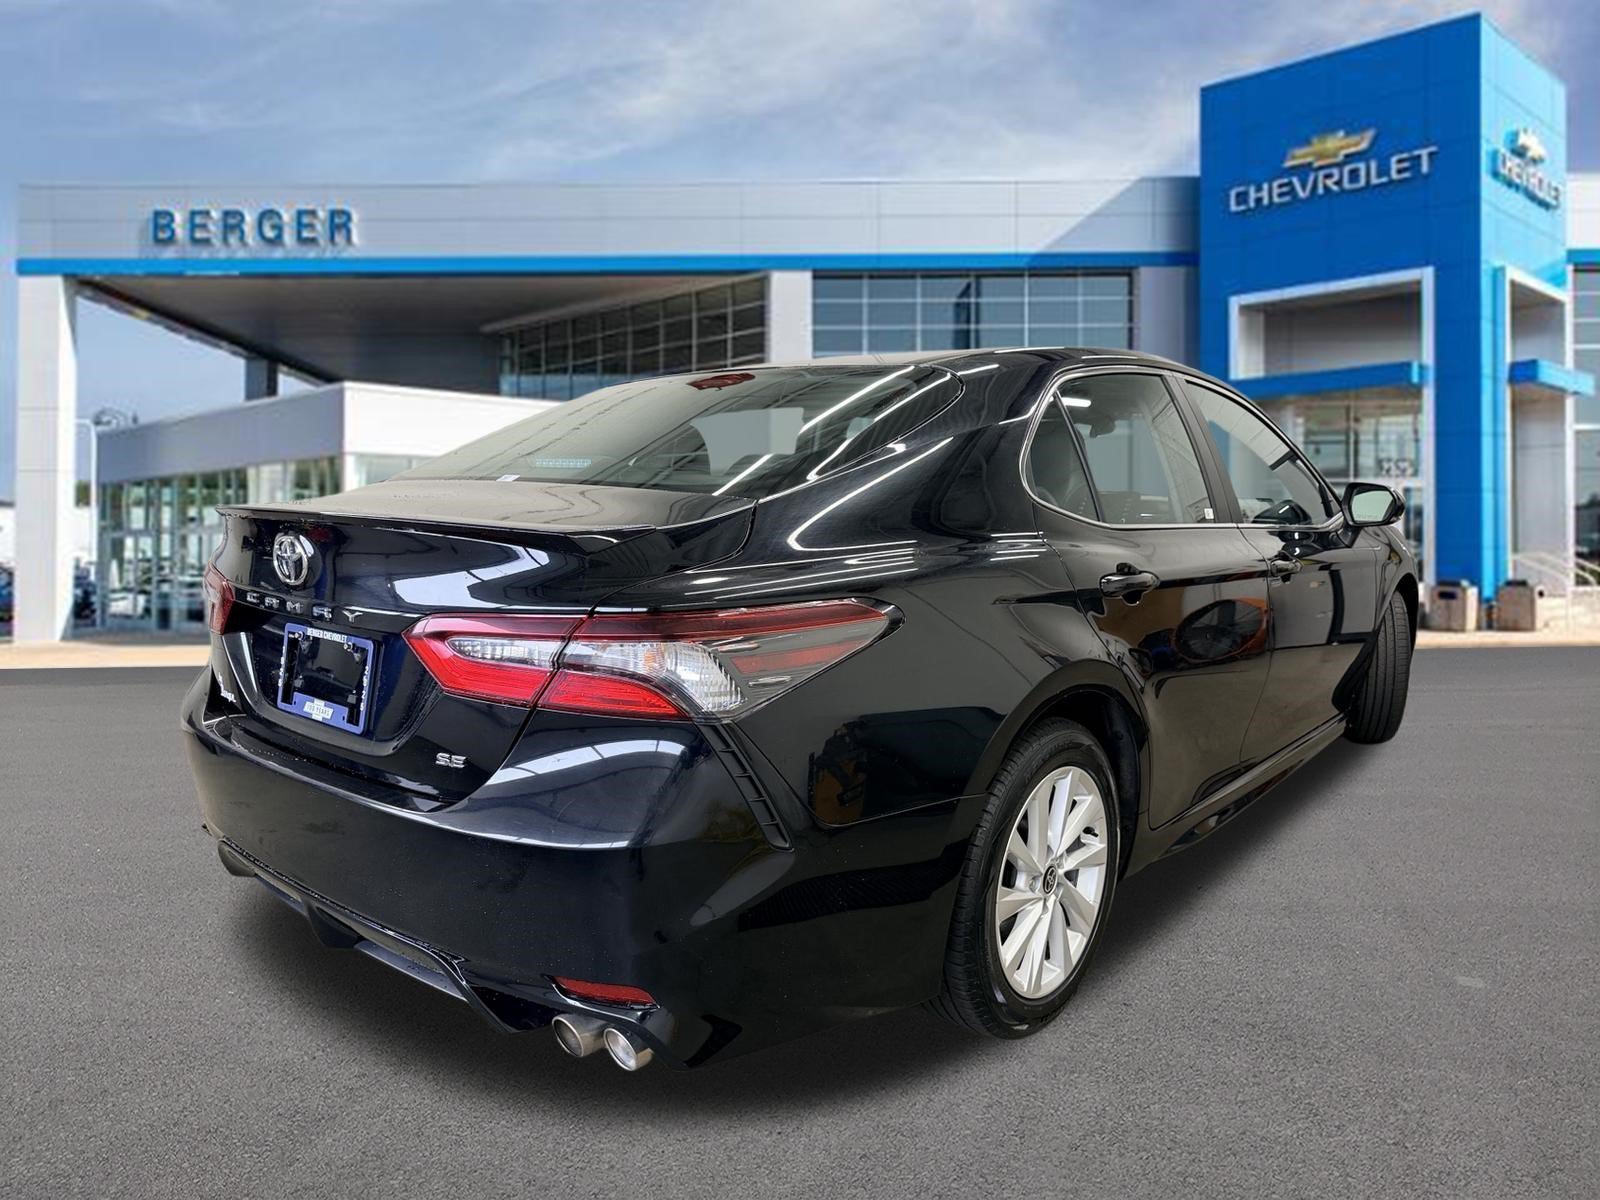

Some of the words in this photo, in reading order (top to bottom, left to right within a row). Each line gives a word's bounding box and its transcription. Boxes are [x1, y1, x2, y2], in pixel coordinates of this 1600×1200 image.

[1229, 146, 1438, 213] CHEVROLET
[152, 207, 355, 246] BERGER
[246, 592, 364, 623] CAMRY
[435, 752, 467, 769] SE
